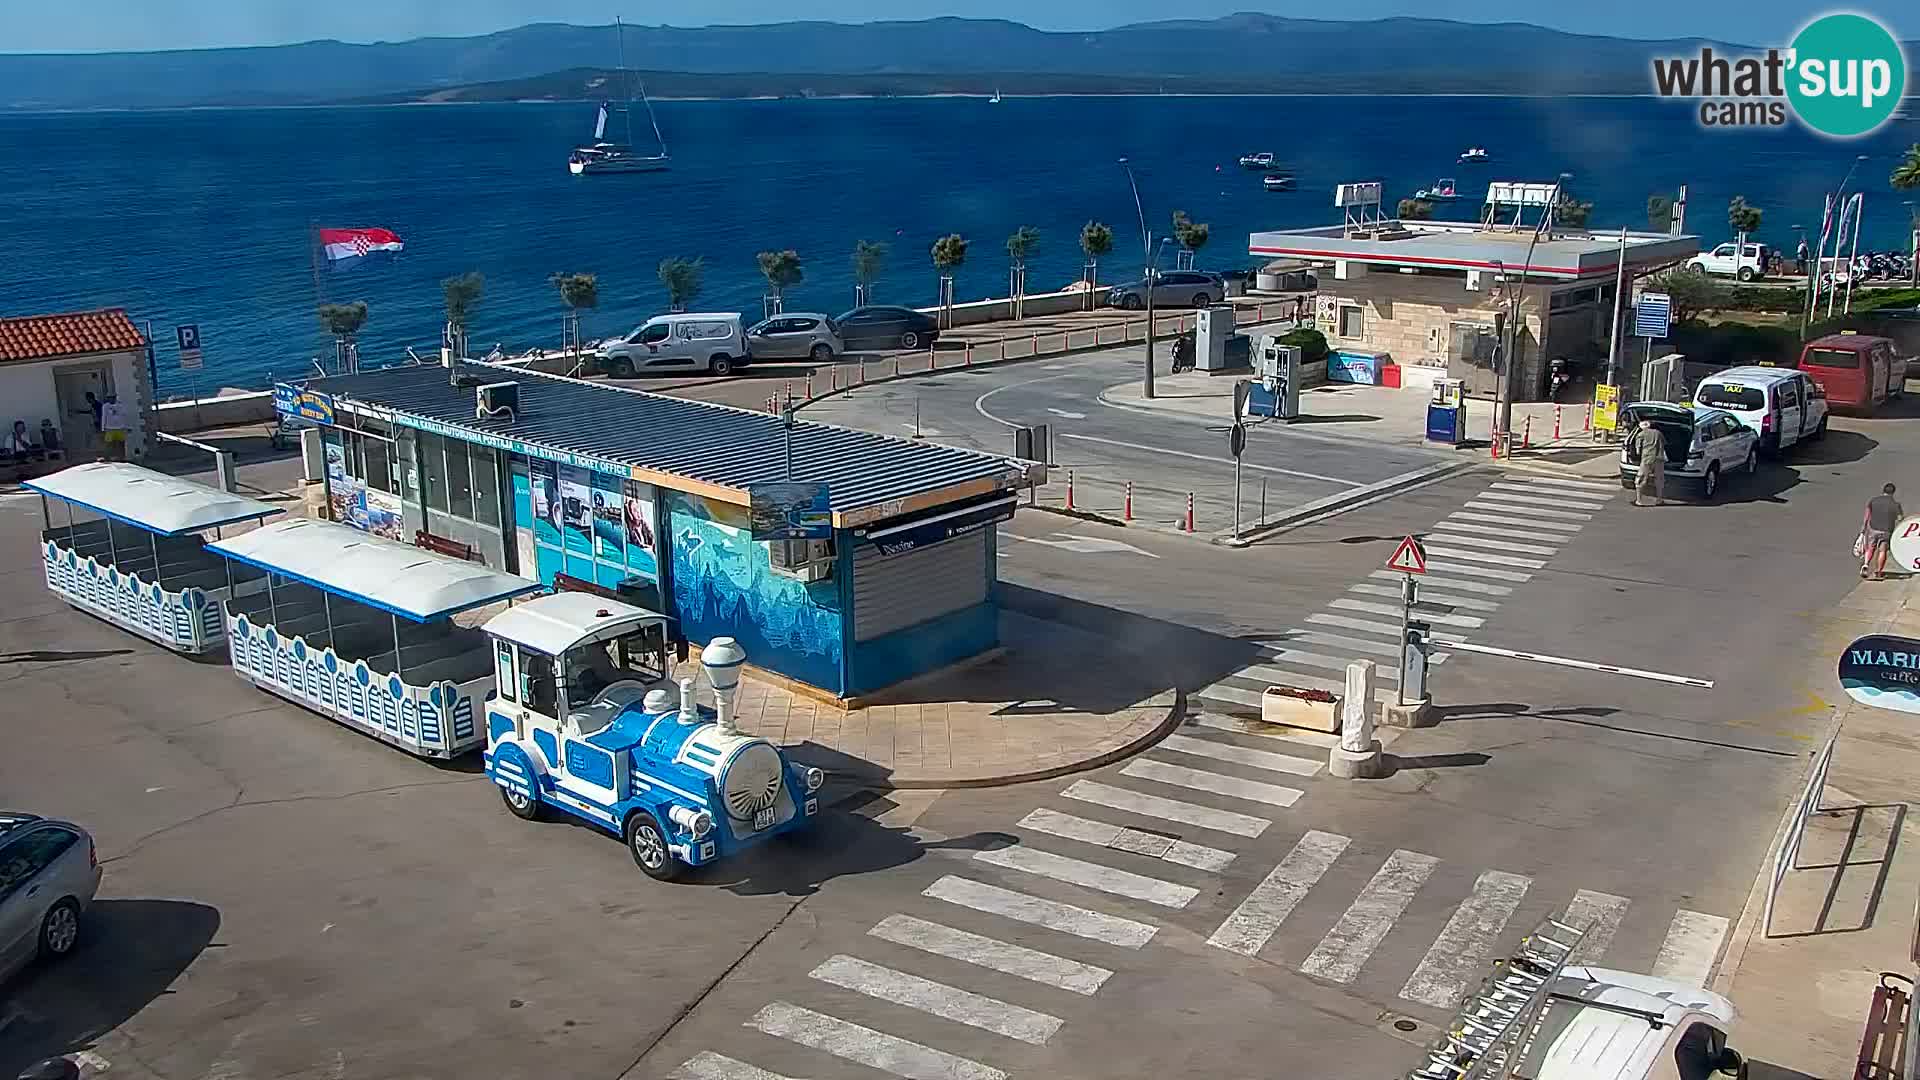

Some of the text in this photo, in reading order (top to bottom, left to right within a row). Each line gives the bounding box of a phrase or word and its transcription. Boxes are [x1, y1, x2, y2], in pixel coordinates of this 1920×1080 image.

[182, 329, 194, 347] P
[1723, 384, 1743, 393] TAXI
[483, 434, 513, 448] POSTAJA
[524, 445, 539, 457] BUS
[539, 447, 571, 462] STATION
[575, 456, 598, 470] TICKET
[600, 461, 627, 476] OFFICE
